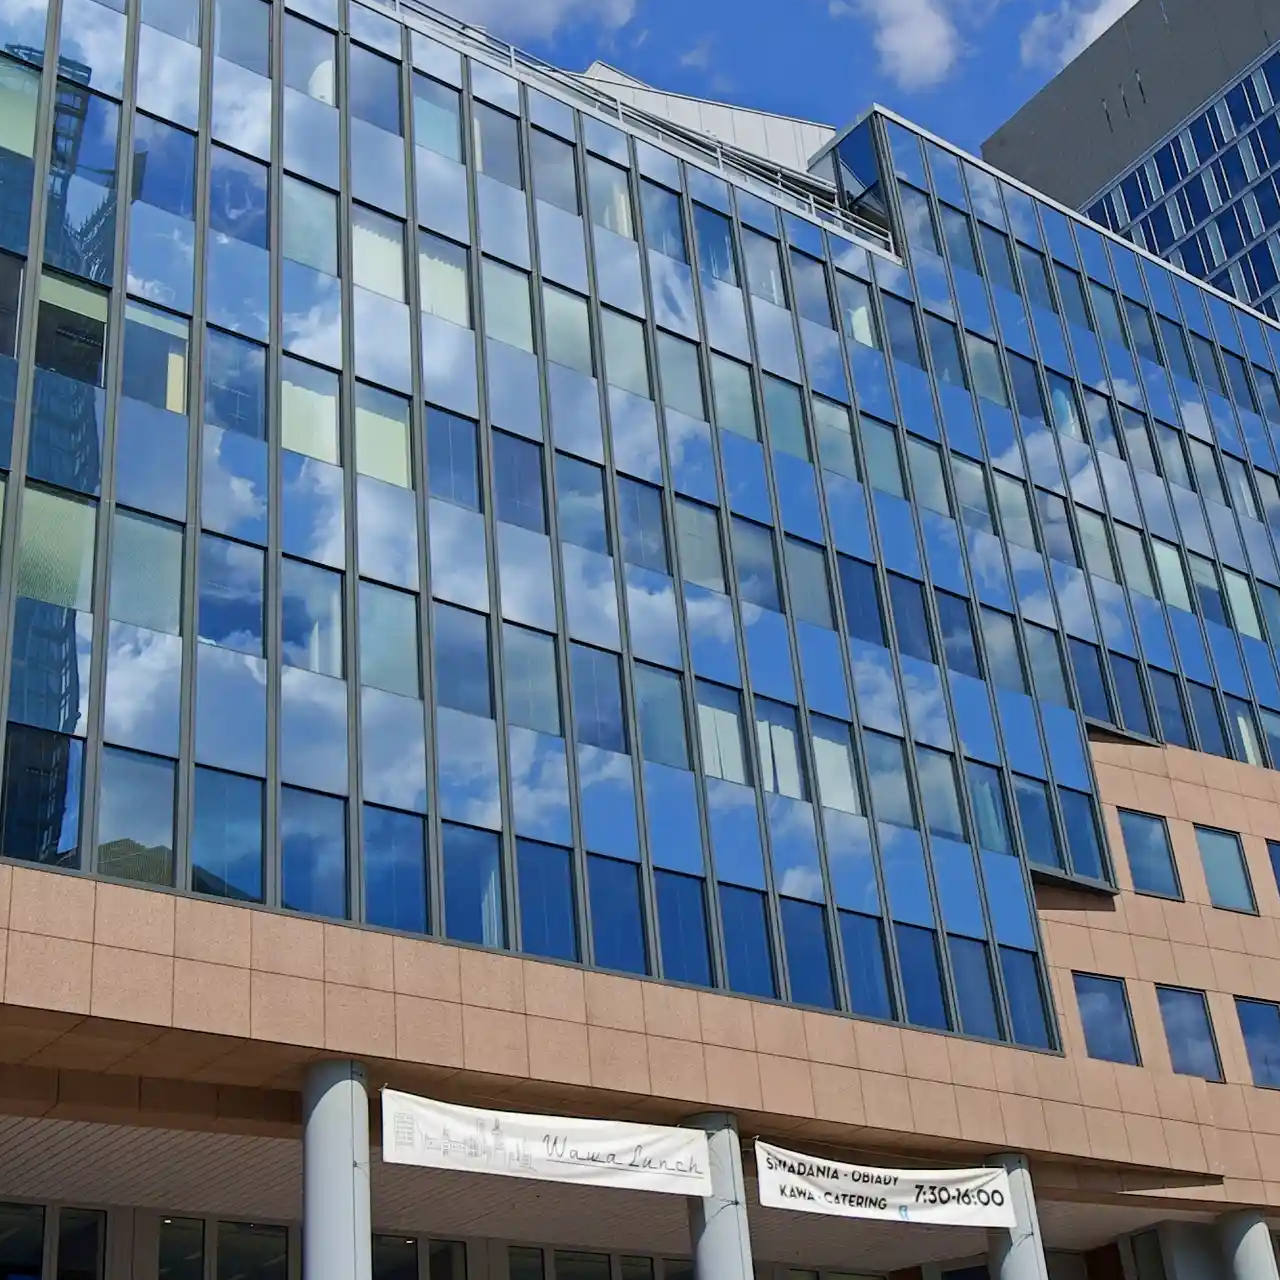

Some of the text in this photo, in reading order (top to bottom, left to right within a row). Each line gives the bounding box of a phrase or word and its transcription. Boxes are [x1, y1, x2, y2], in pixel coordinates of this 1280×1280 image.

[542, 1133, 705, 1175] Wawa Lunch
[851, 1169, 899, 1186] OBIADY
[824, 1191, 888, 1210] CATERING
[914, 1184, 1005, 1207] 7:30-16:00
